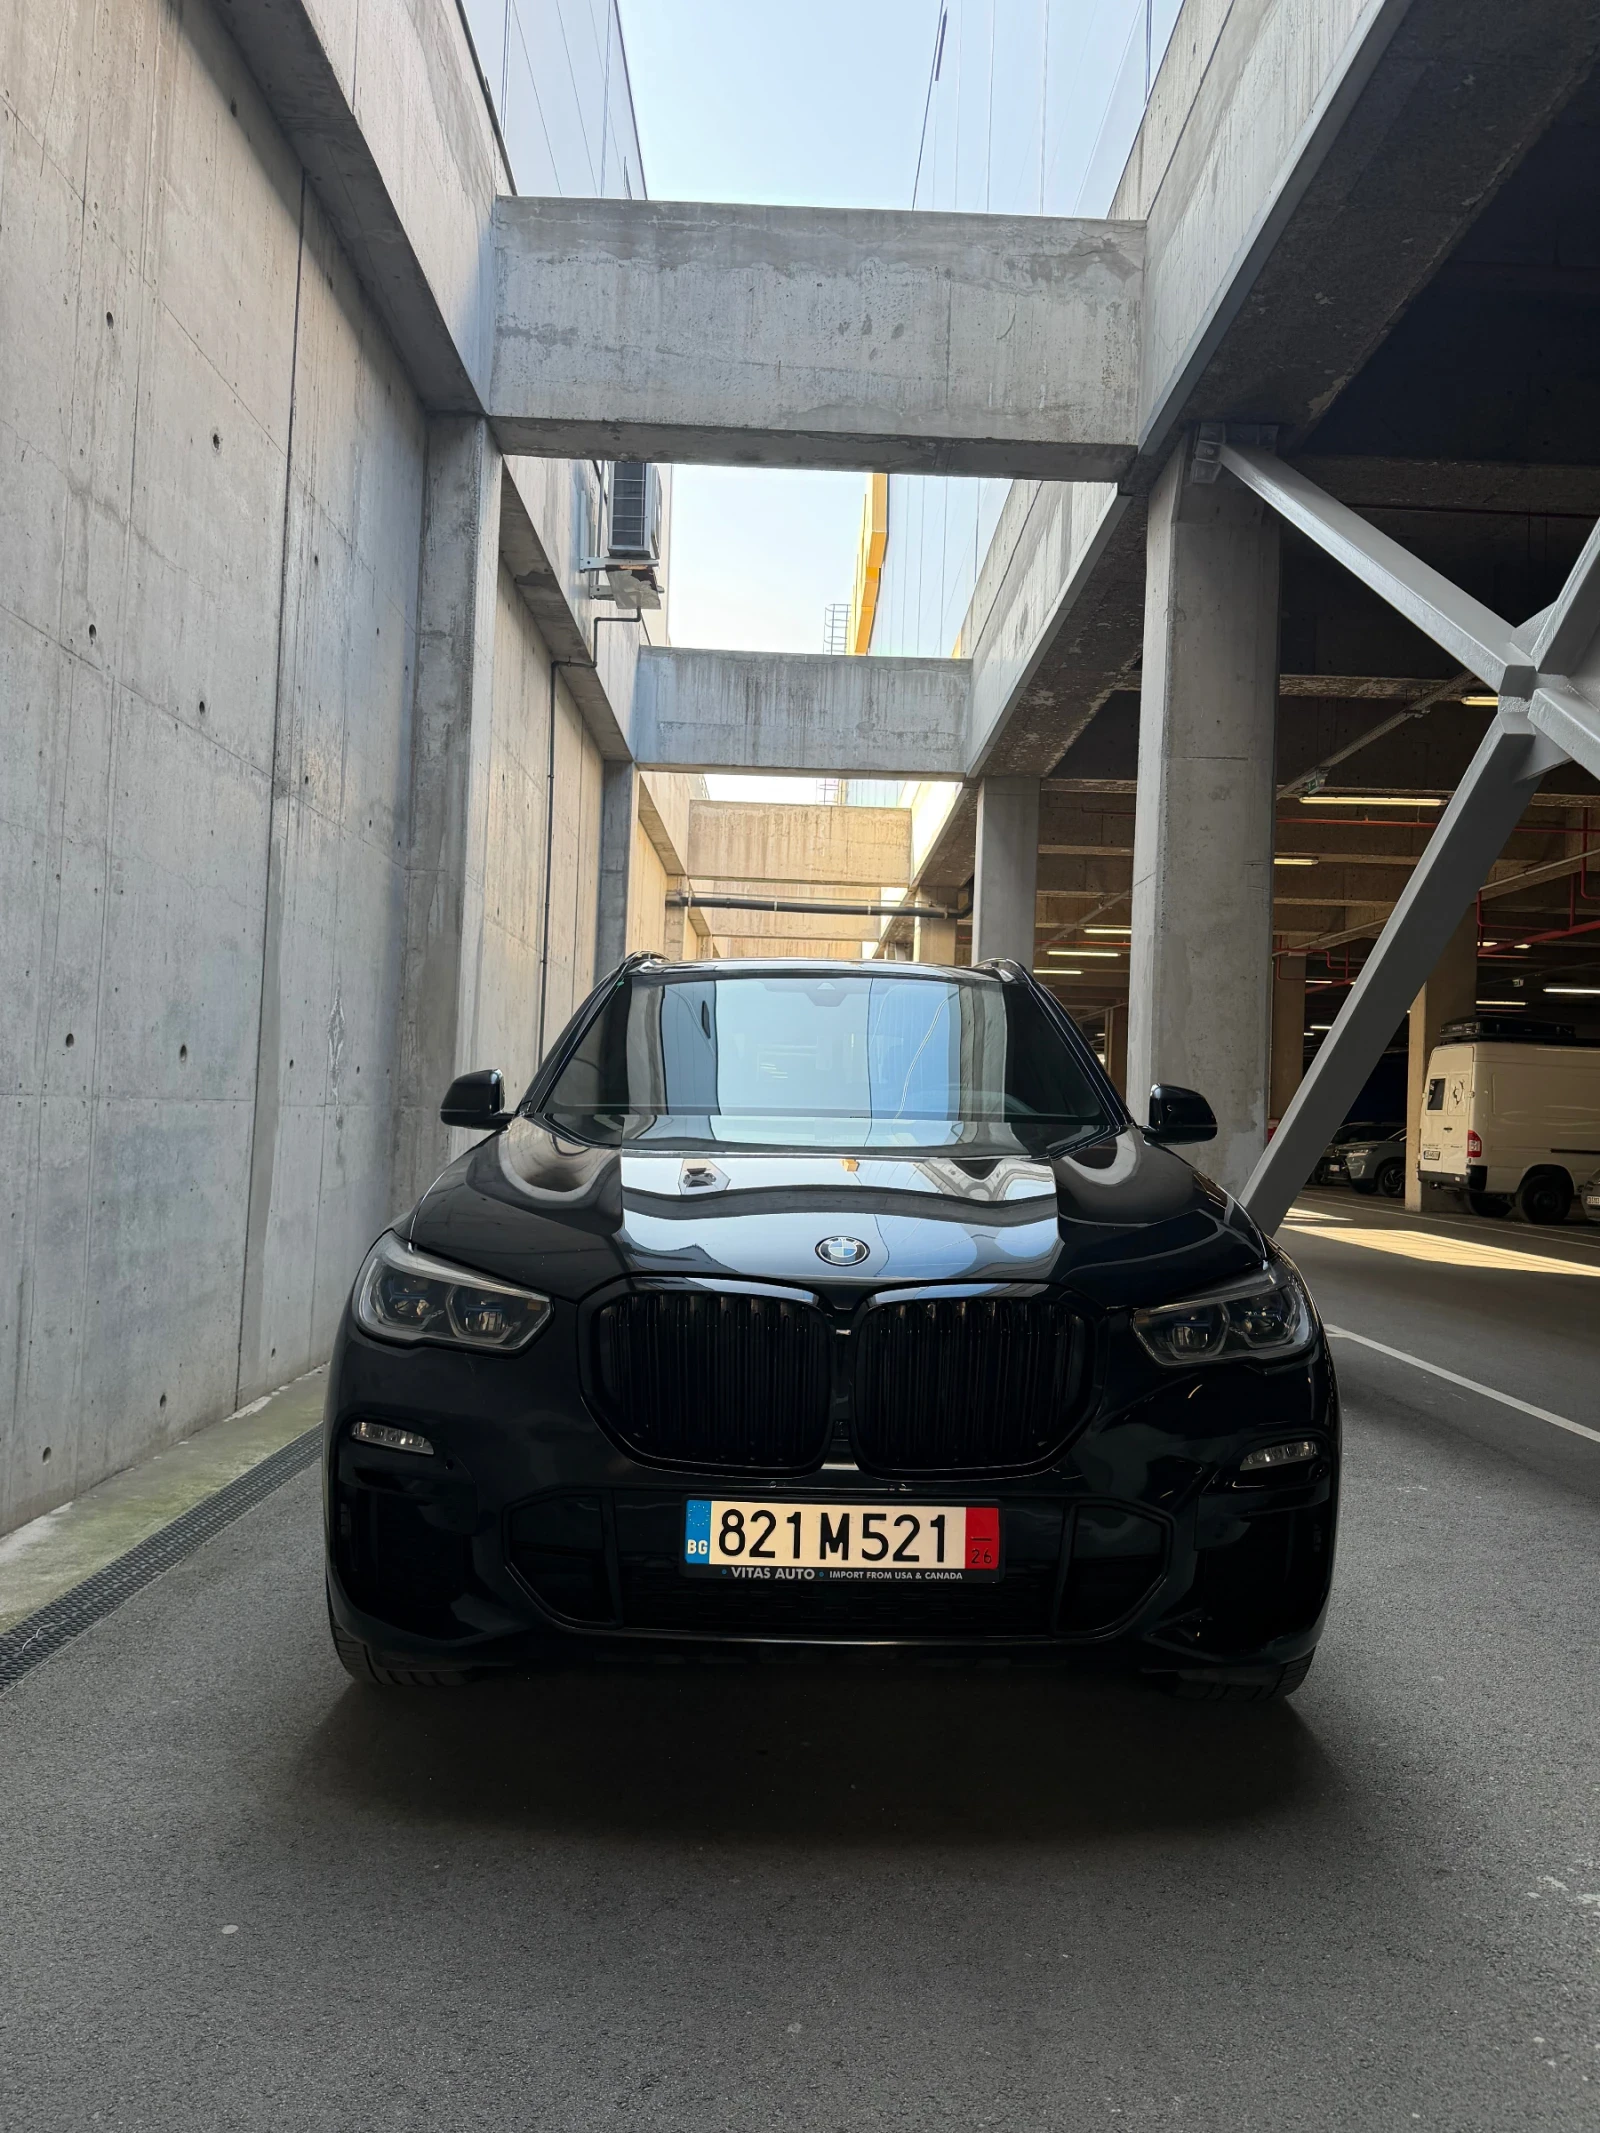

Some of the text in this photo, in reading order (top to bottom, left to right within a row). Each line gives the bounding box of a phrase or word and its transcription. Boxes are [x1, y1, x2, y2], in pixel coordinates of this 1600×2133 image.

[687, 1539, 708, 1555] BG
[970, 1548, 993, 1564] 26
[731, 1566, 815, 1580] VITAS AUTO
[829, 1570, 963, 1580] IMPORT FROM USA & CANADA
